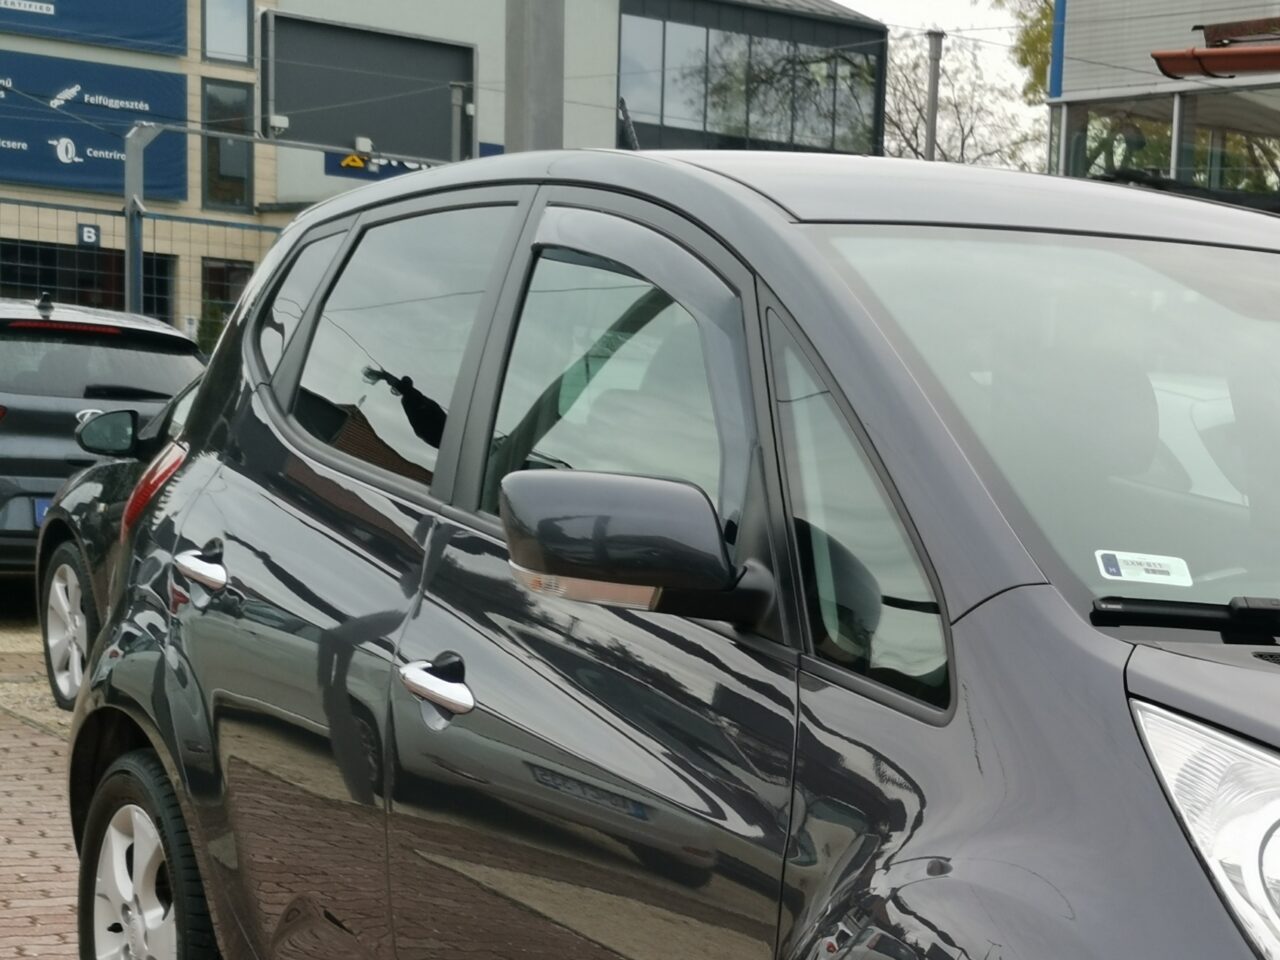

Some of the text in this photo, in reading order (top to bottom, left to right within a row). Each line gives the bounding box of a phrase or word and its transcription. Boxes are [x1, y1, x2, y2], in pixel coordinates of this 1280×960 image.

[0, 0, 51, 12] ERTIFIED
[84, 94, 149, 111] Felfüggesztés
[0, 139, 28, 150] csere
[83, 228, 96, 244] B
